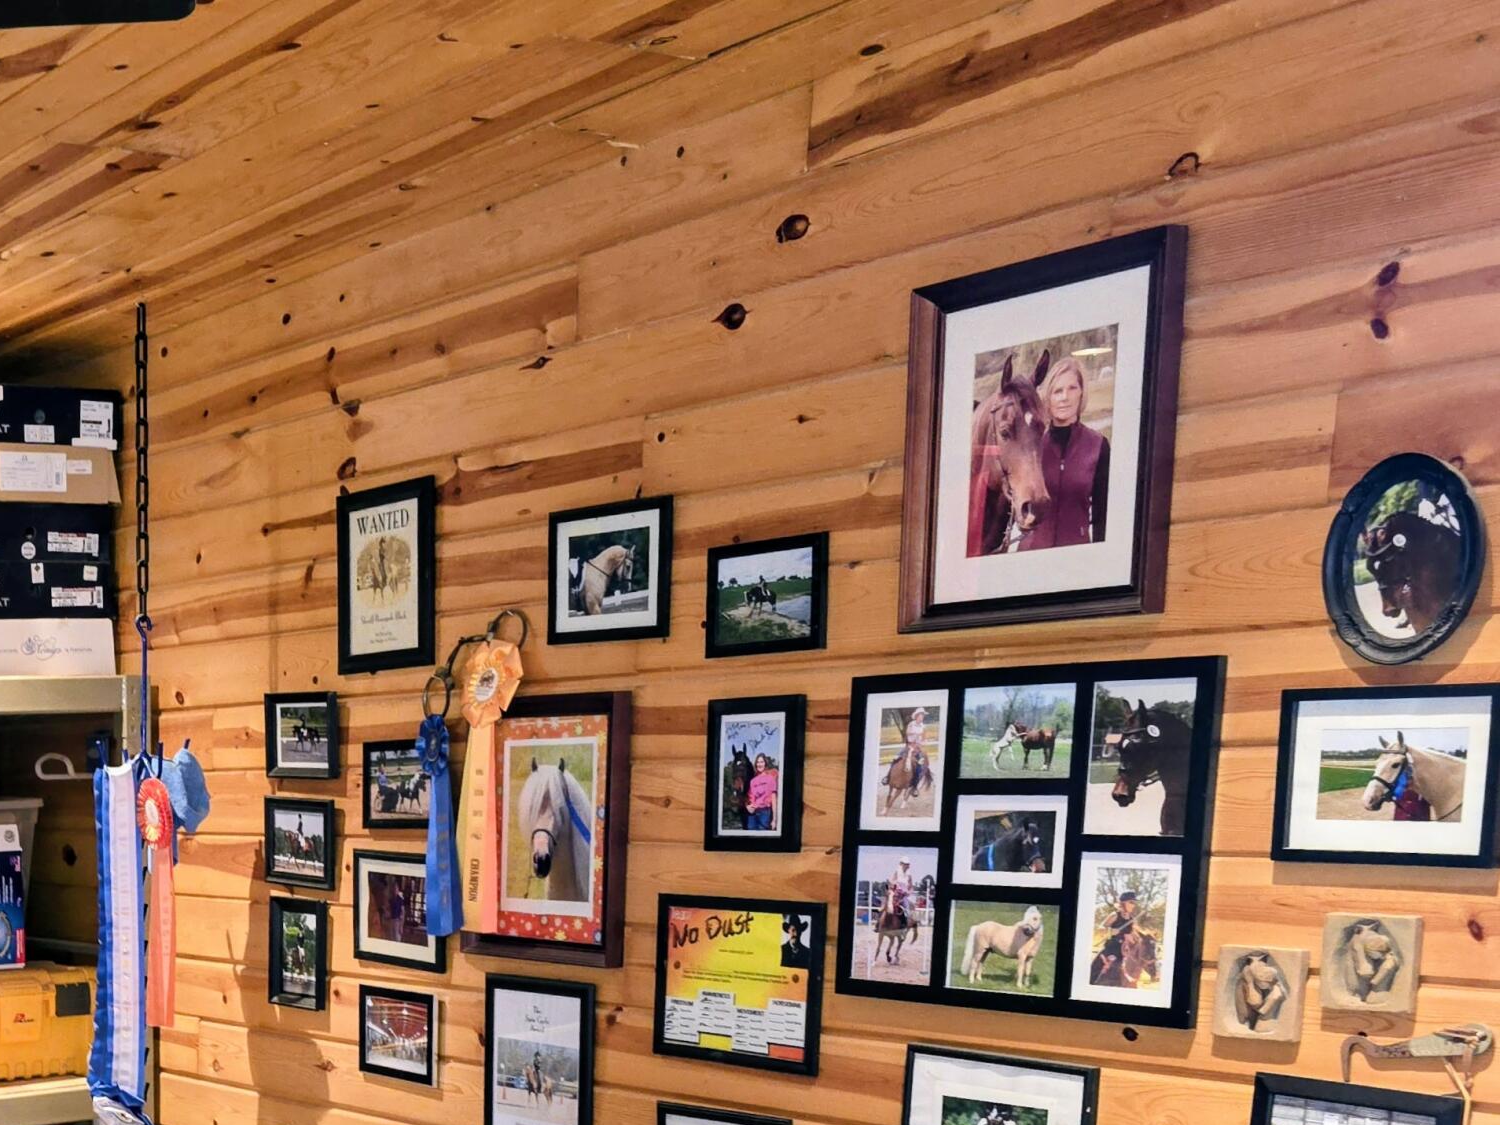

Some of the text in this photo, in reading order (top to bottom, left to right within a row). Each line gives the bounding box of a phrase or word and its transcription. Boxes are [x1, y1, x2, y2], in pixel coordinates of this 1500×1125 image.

[356, 507, 410, 536] WANTED
[468, 858, 480, 902] CHAMPION
[670, 911, 754, 949] No Dust
